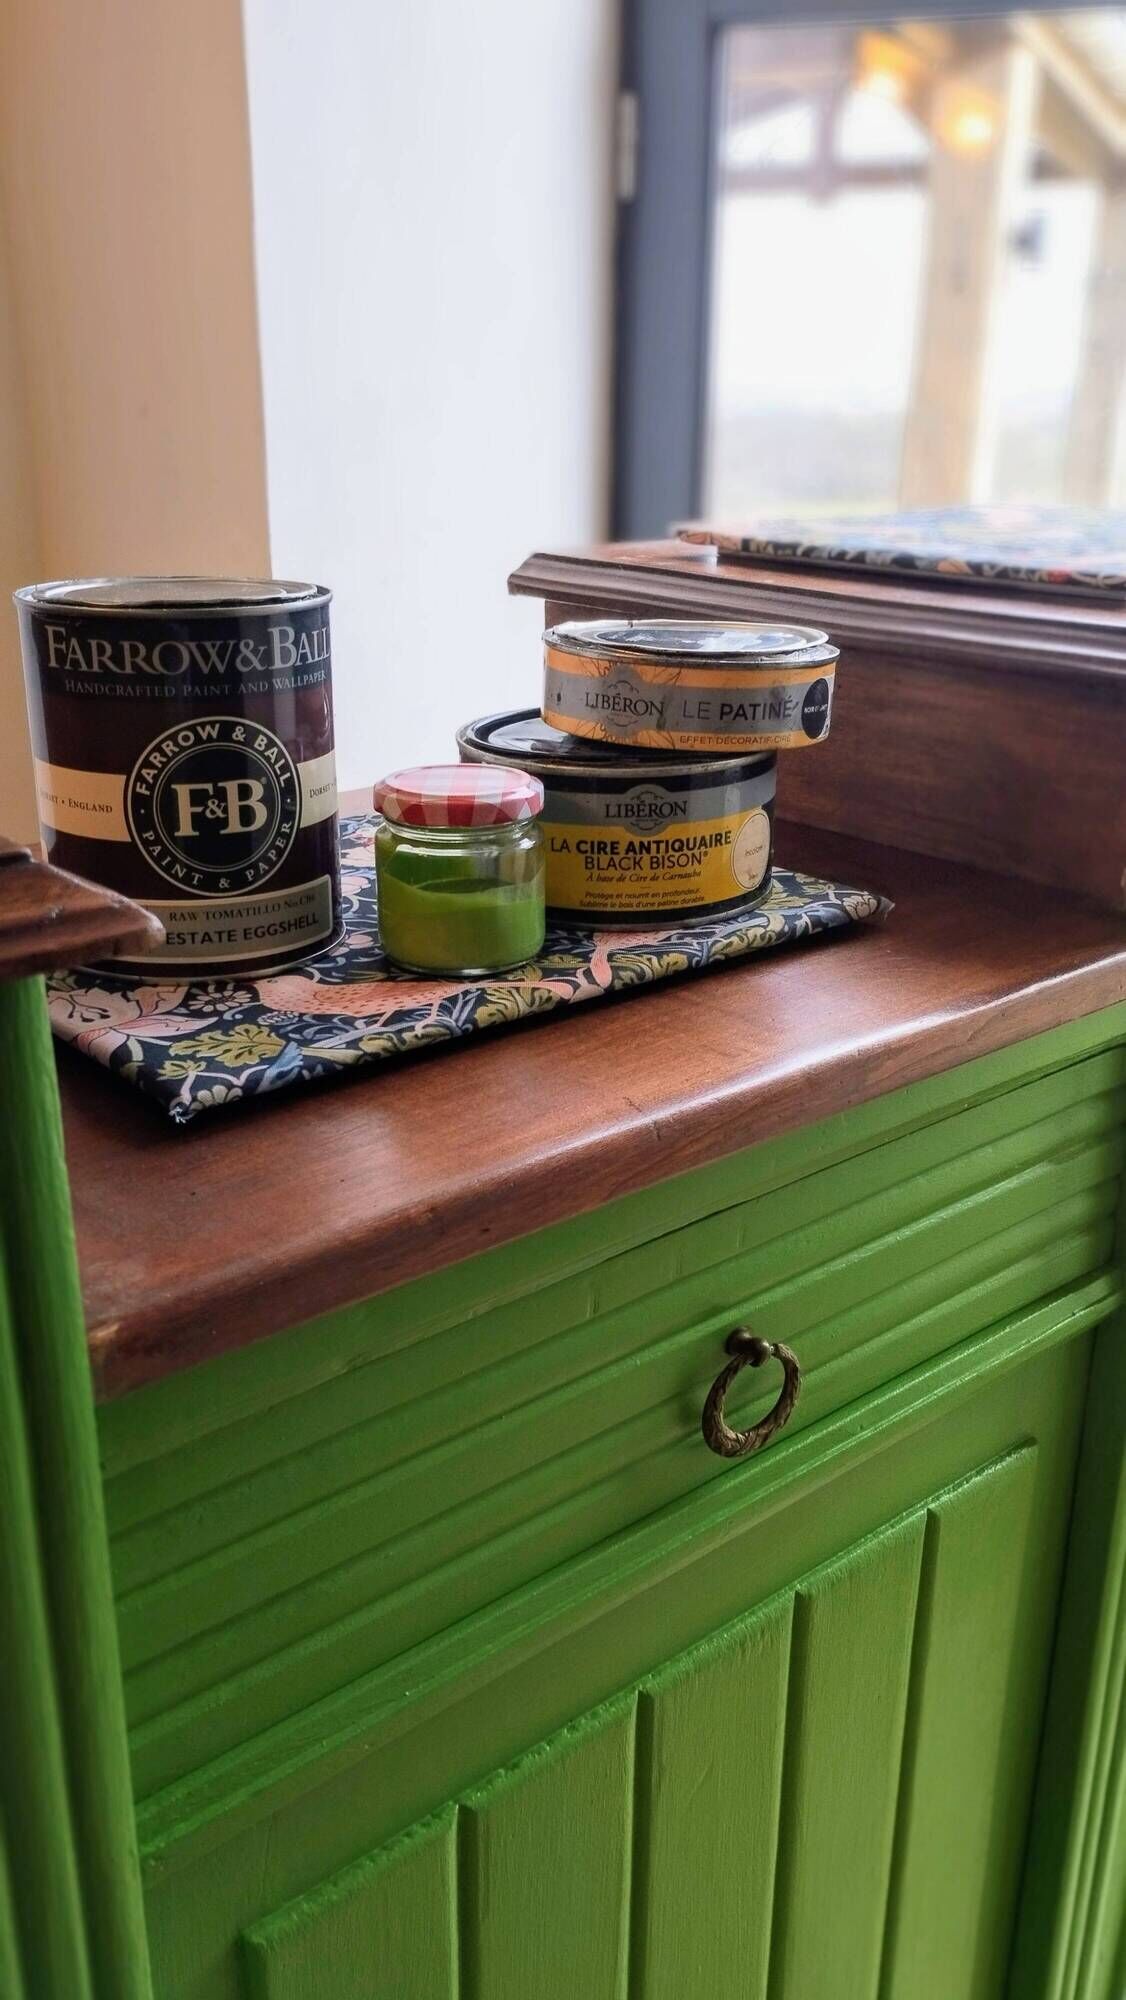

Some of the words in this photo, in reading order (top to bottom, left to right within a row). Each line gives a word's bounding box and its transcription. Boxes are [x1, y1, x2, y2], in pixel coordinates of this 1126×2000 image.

[65, 679, 176, 697] HANDCRAFTED
[183, 684, 231, 697] PAINT
[238, 681, 268, 694] AND
[272, 670, 328, 690] WALLPAPER
[585, 692, 665, 717] LIBÉRON
[682, 701, 712, 719] LE
[679, 735, 715, 745] EFFET
[136, 723, 221, 796] FARROW
[232, 725, 247, 742] &
[254, 735, 289, 788] BALL
[68, 797, 113, 813] ENGLAND
[605, 799, 688, 819] LIBÉRON
[551, 837, 571, 853] LA
[576, 840, 625, 856] CIRE
[625, 830, 732, 855] ANTIQUAIRE
[142, 831, 203, 886] PAINT
[219, 877, 232, 889] &
[246, 820, 292, 882] PAPER
[584, 854, 644, 871] BLACK
[169, 911, 198, 922] RAW
[203, 903, 281, 921] TOMATILLO
[166, 929, 237, 946] ESTATE
[243, 912, 319, 941] EGGSHELL
